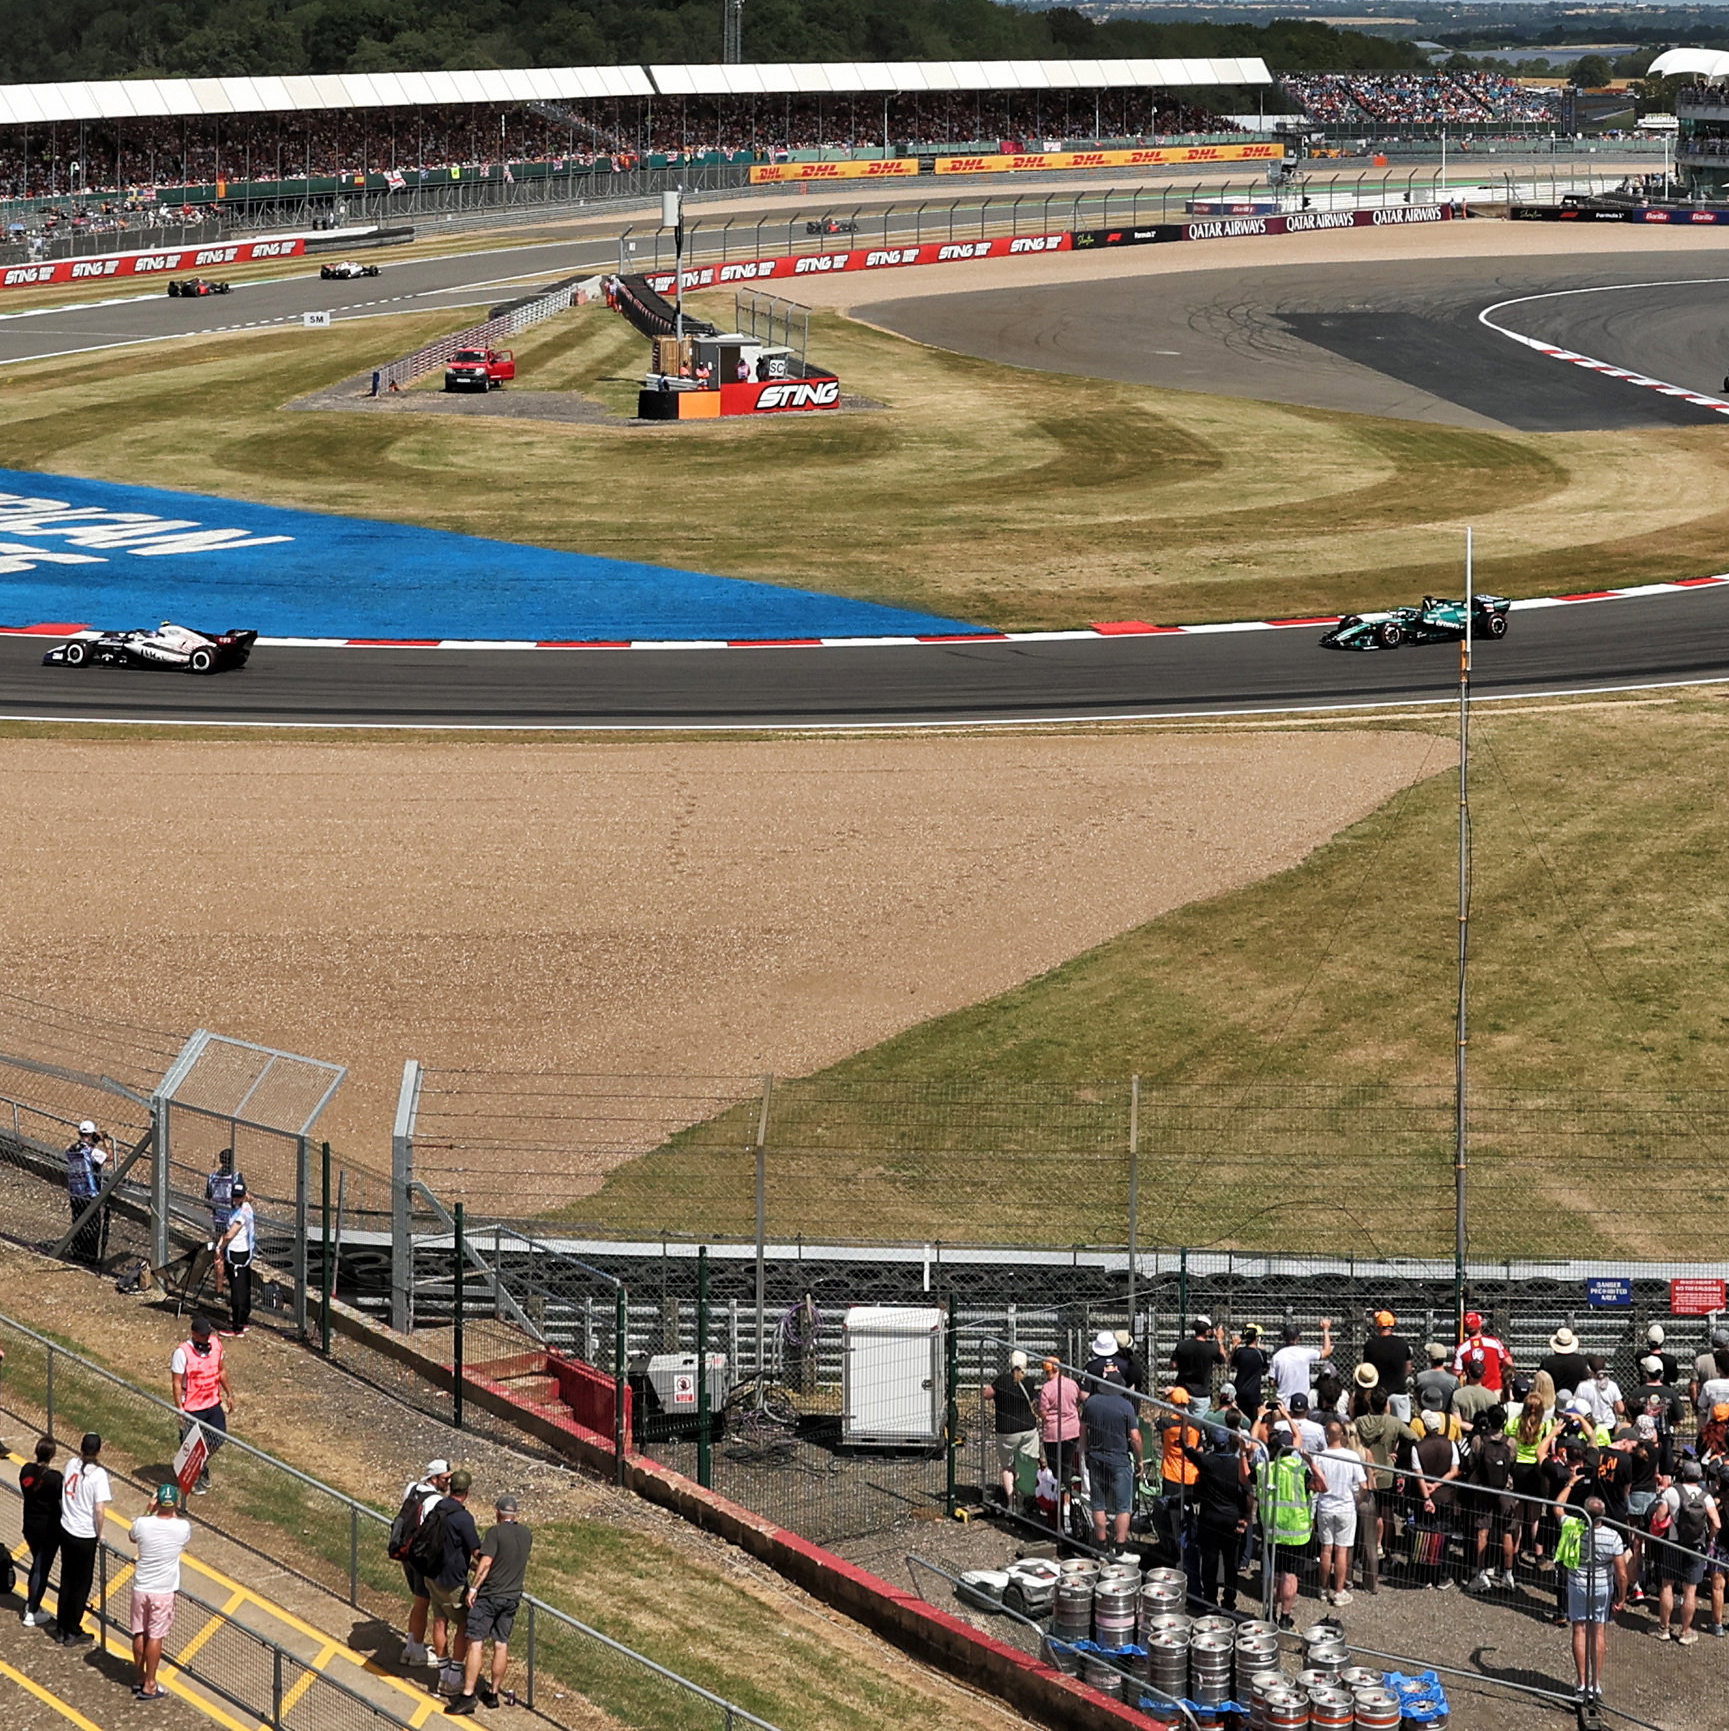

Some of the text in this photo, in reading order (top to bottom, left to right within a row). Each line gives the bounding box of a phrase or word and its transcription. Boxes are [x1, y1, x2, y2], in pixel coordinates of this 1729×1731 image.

[1072, 153, 1106, 167] DHL
[1131, 150, 1162, 163] DHL
[1188, 148, 1218, 160] DHL
[1242, 146, 1273, 158] DHL
[868, 162, 904, 175] DHL
[950, 157, 986, 171] DHL
[1013, 156, 1046, 168] DHL
[759, 167, 782, 181] DHL
[801, 165, 839, 177] DHL
[1286, 212, 1355, 232] QATAR AIRWAYS
[1373, 206, 1442, 226] QATAR AIRWAYS
[1645, 212, 1668, 220] Barilla
[1692, 212, 1714, 221] Barilla
[1189, 219, 1266, 240] QATAR AIRWAYS
[251, 241, 280, 258] STING
[938, 243, 974, 260] STING
[1009, 237, 1046, 253] STING
[134, 255, 165, 271] STING
[195, 248, 224, 265] STING
[794, 256, 832, 273] STING
[865, 249, 901, 266] STING
[4, 269, 38, 286] STING
[71, 262, 104, 278] STING
[720, 262, 757, 281] STING
[309, 315, 324, 325] SM
[770, 362, 784, 374] SC
[756, 382, 839, 409] STING
[64, 1473, 80, 1500] 4
